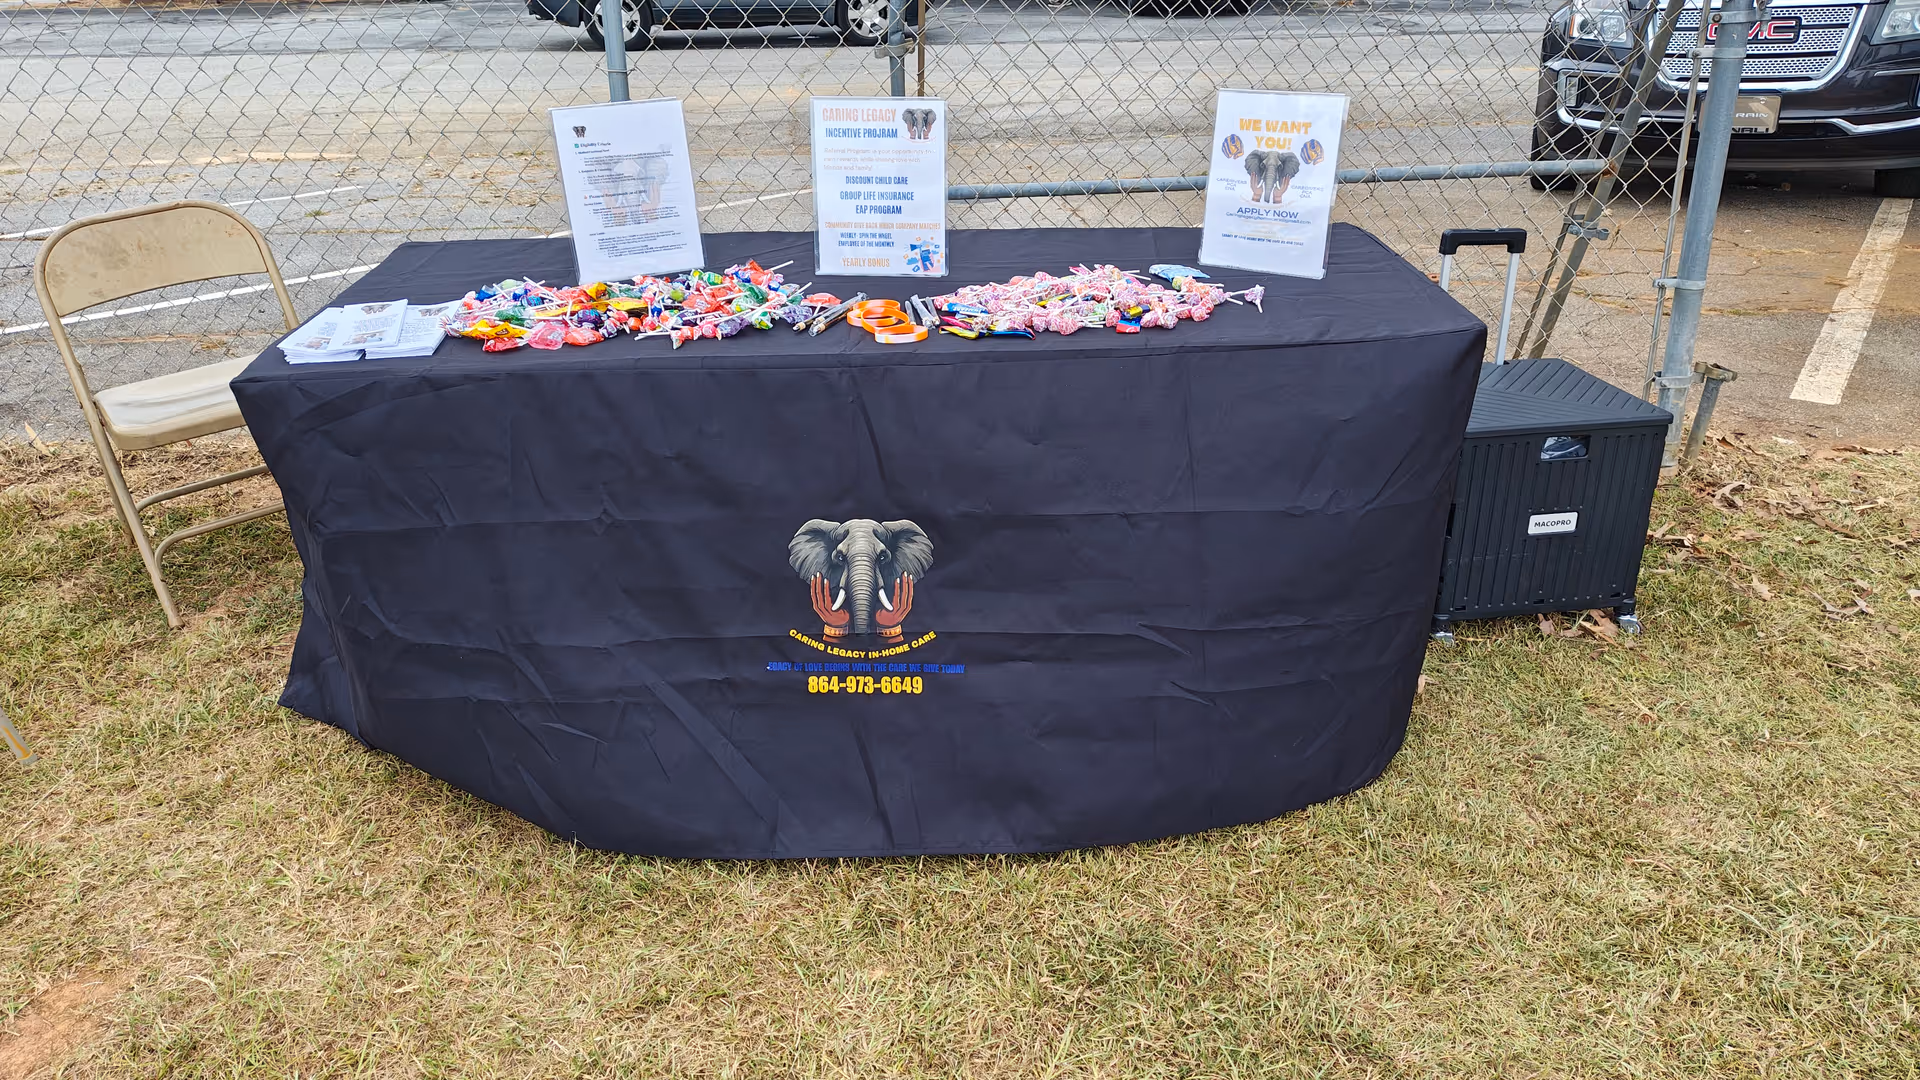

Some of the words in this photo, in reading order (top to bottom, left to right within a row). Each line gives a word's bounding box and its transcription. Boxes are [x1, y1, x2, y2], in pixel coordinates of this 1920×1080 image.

[822, 107, 859, 122] CARING
[861, 107, 896, 123] LEGACY
[825, 127, 862, 138] INCENTIVE
[1239, 118, 1262, 132] WE
[1265, 119, 1312, 135] WANT
[1254, 135, 1292, 151] YOU!
[845, 176, 874, 185] DISCOUNT
[874, 176, 892, 185] CHILD
[893, 177, 909, 185] CARE
[840, 191, 862, 201] GROUP
[863, 191, 876, 201] LIFE
[877, 191, 914, 201] INSURANCE
[855, 204, 868, 215] EAP
[869, 205, 902, 215] PROGRAM
[1236, 206, 1272, 217] APPLY
[1272, 209, 1299, 219] NOW
[841, 257, 866, 267] YEARLY
[867, 258, 890, 268] BONUS
[1533, 519, 1572, 528] MACOPRO
[789, 629, 825, 651] CARING
[826, 645, 866, 659] LEGACY
[868, 643, 911, 659] IN-HOME
[911, 630, 937, 648] CARE
[804, 662, 823, 672] LOVE
[824, 662, 850, 672] BEGINS
[851, 663, 872, 672] WITH
[873, 663, 887, 672] THE
[888, 663, 907, 672] CARE
[908, 663, 921, 672] WE
[923, 663, 940, 673] GIVE
[941, 664, 965, 674] TODAY
[807, 675, 923, 694] 864-973-6649
